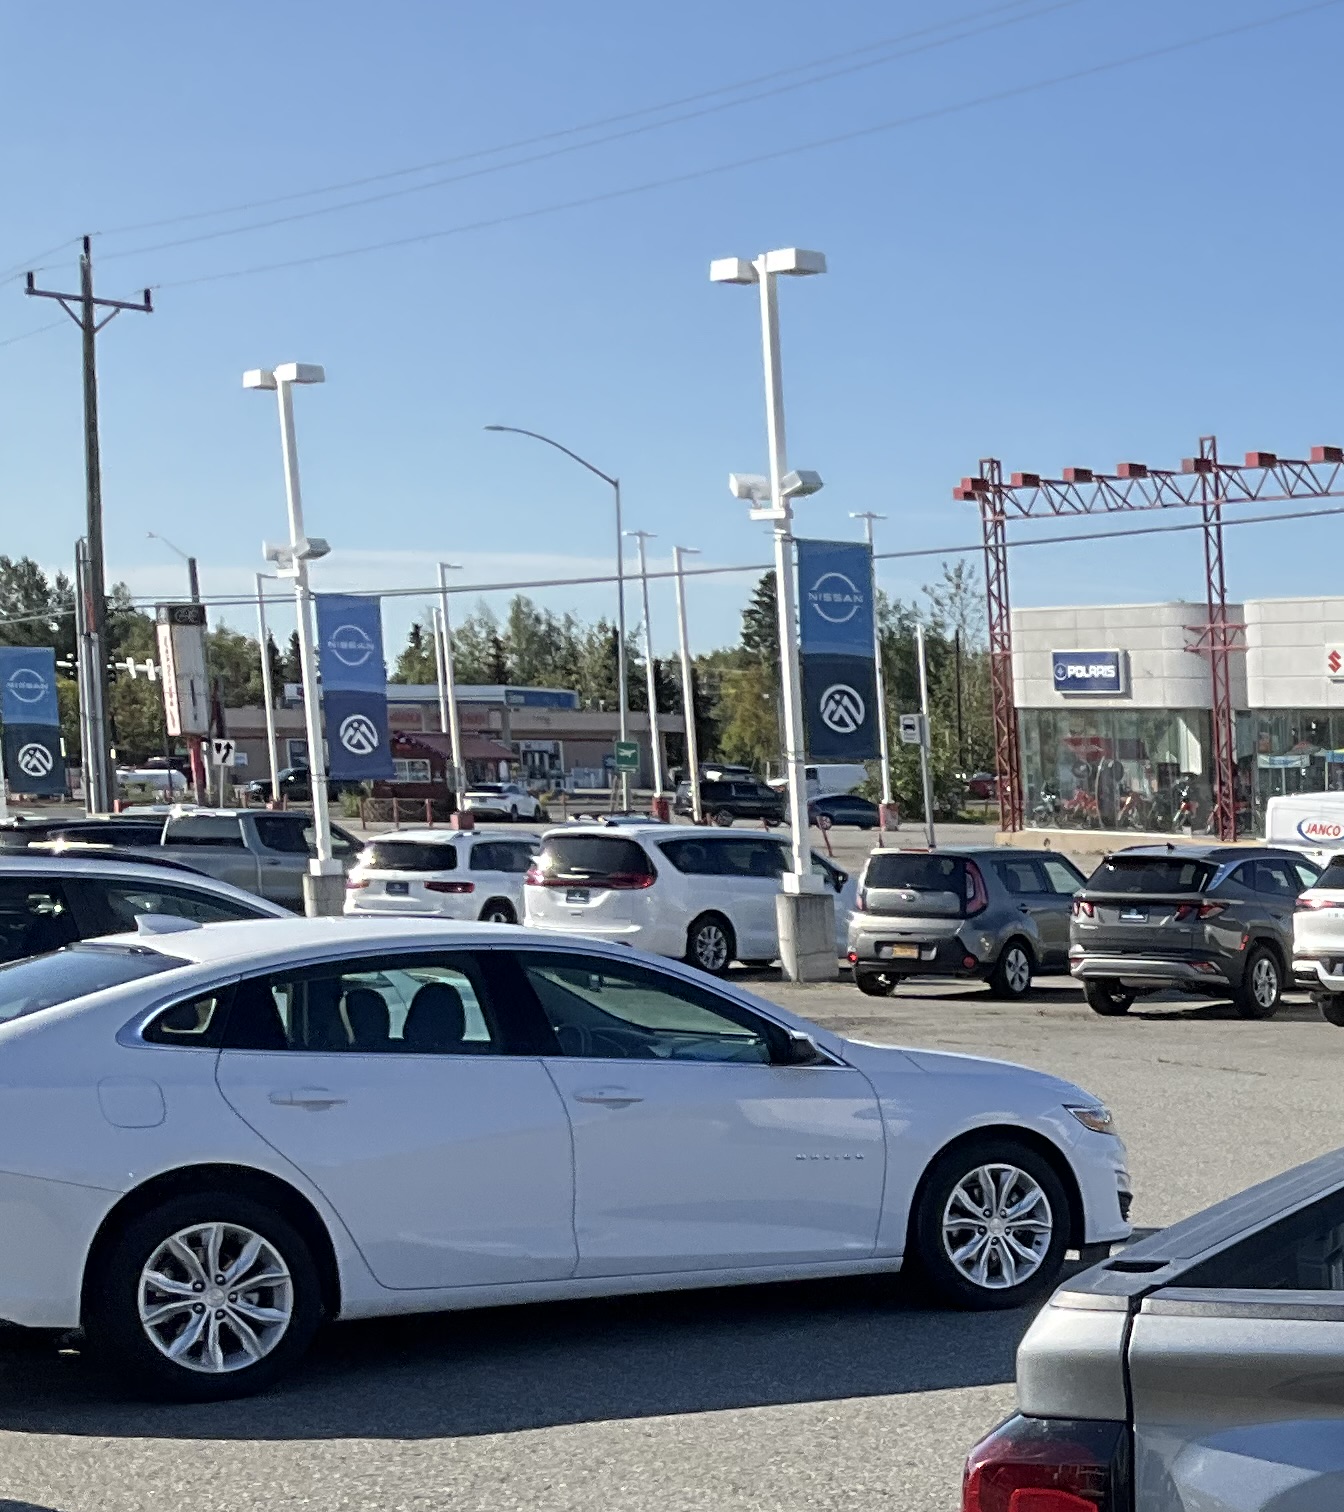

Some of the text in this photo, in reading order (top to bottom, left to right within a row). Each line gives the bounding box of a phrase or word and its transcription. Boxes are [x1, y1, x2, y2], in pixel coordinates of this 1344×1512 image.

[808, 592, 864, 603] NISSAN
[1067, 665, 1116, 679] POLARIS
[1305, 823, 1342, 837] JANCO
